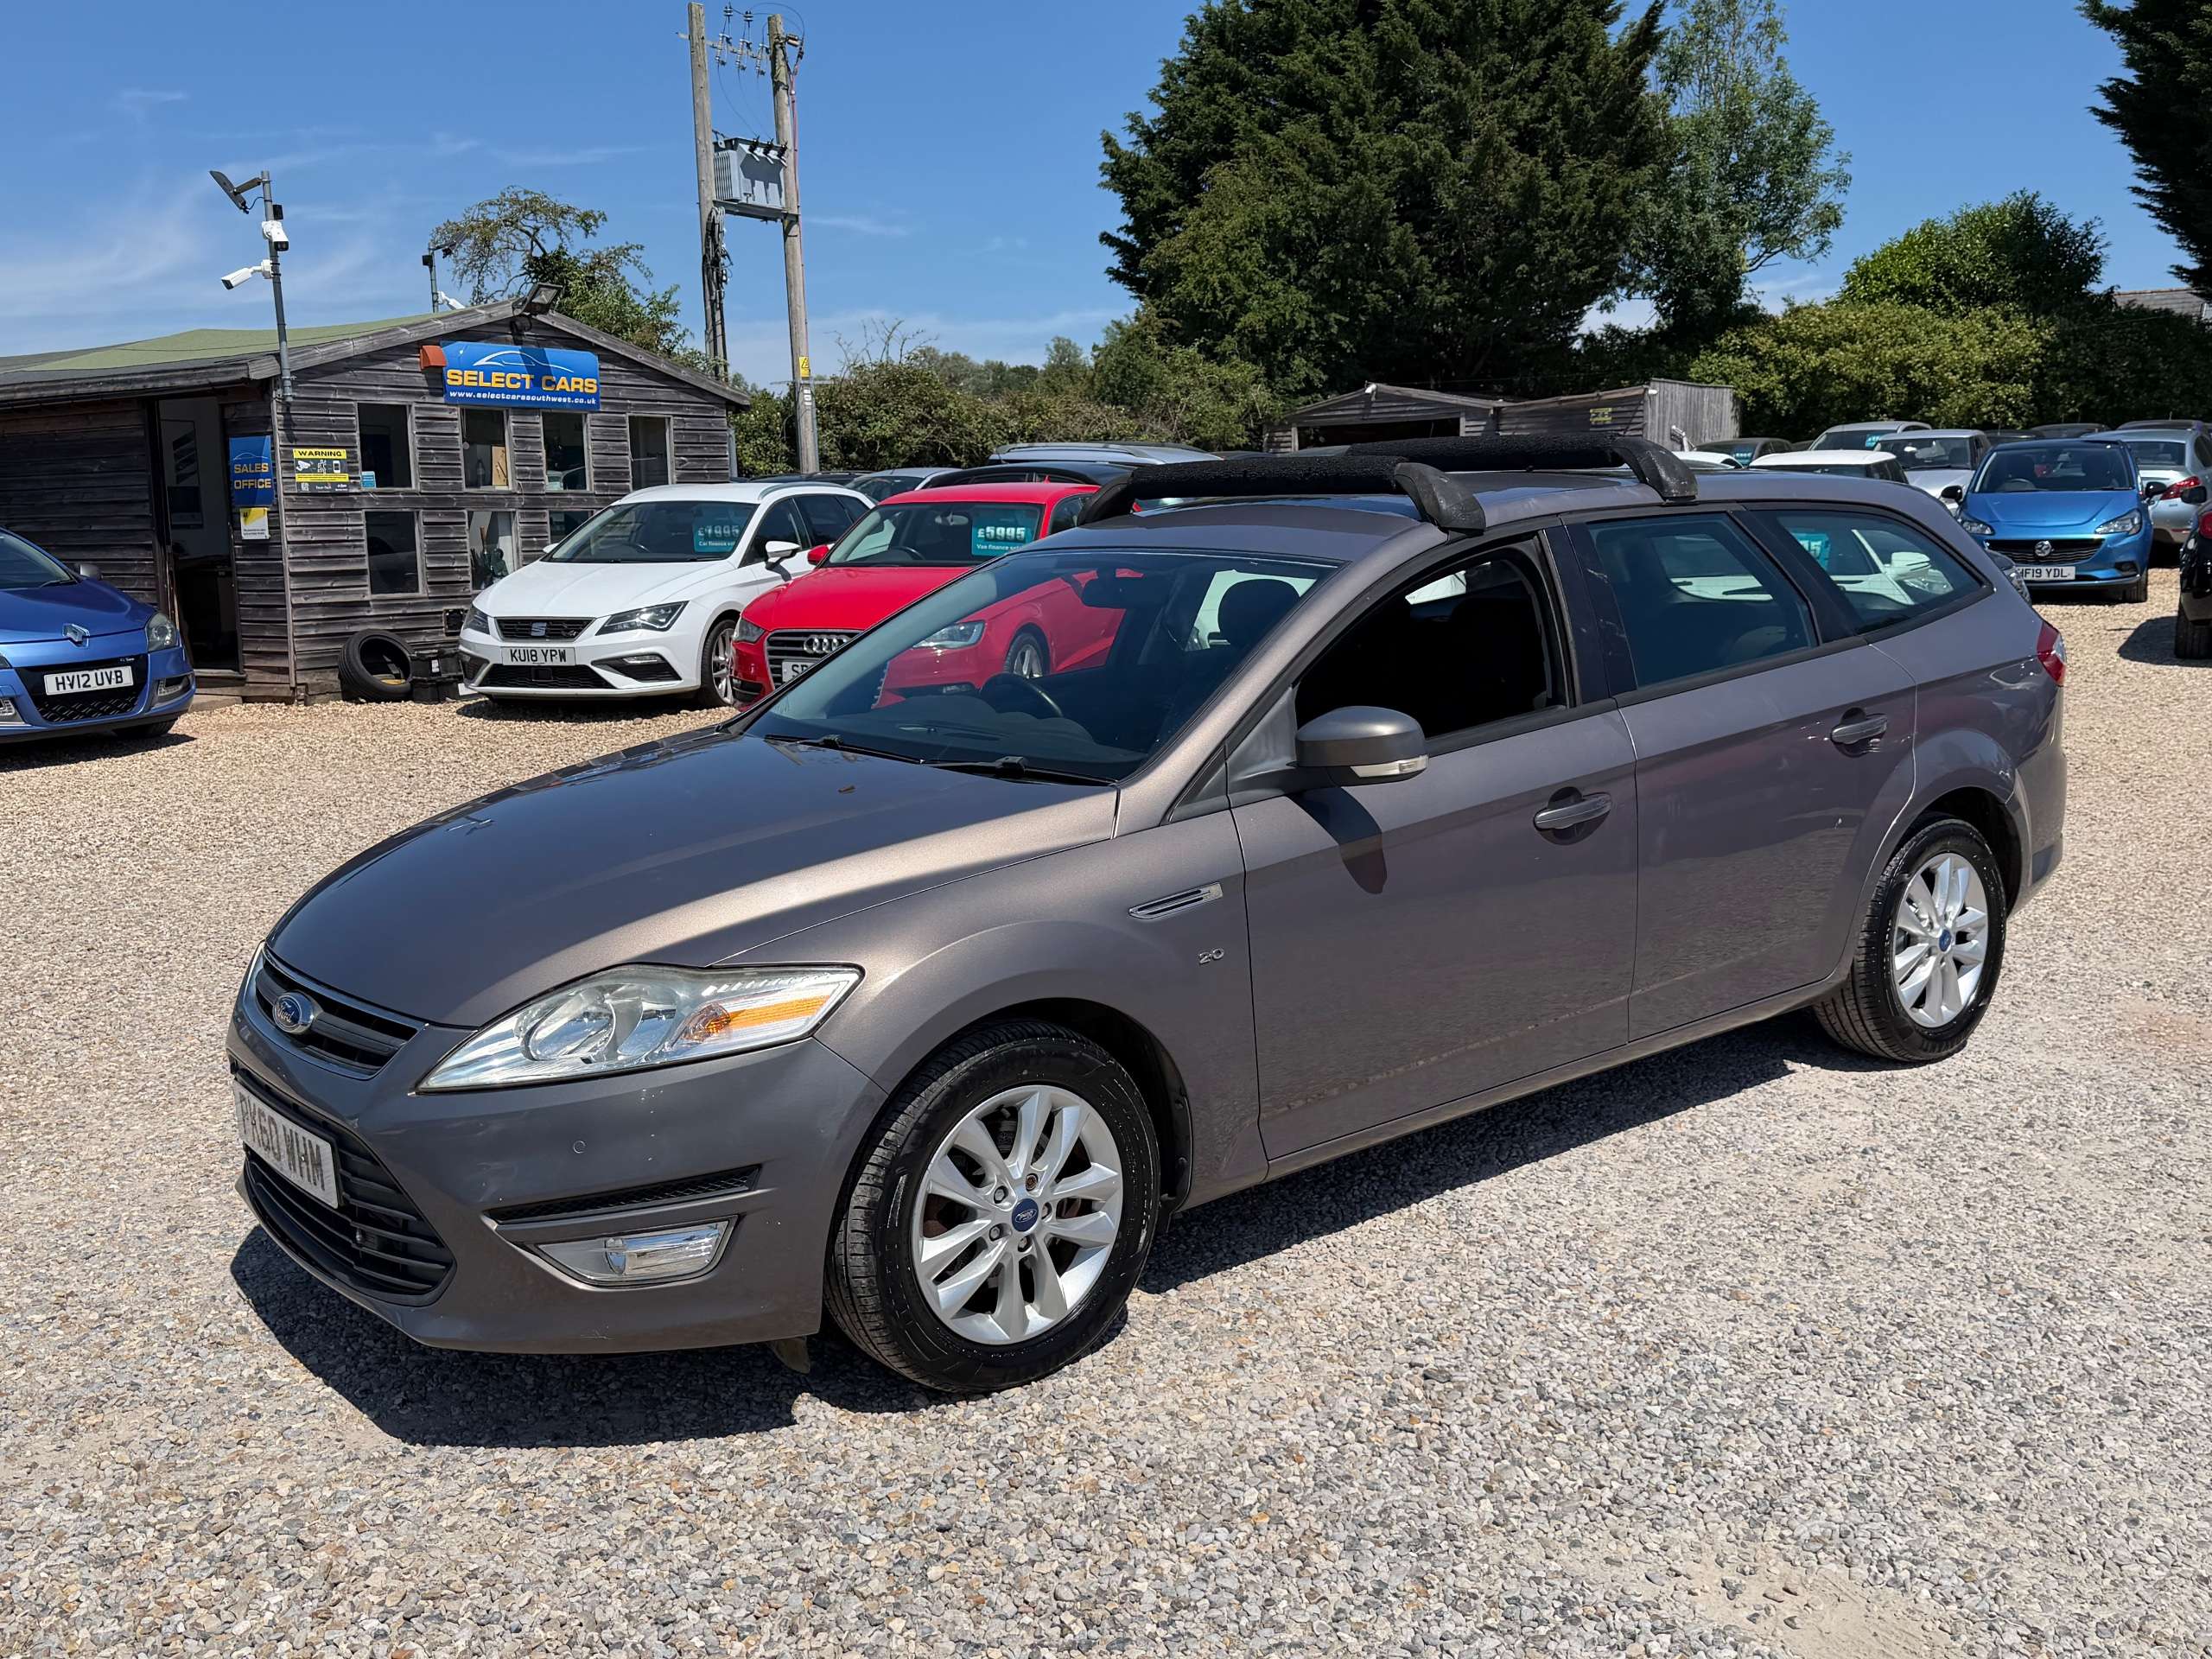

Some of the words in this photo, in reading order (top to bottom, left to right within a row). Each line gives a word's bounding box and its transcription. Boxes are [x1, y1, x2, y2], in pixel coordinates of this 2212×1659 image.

[447, 369, 534, 389] SELECT
[541, 376, 598, 394] CARS
[449, 391, 596, 405] www.selectcarssouthwest.co.uk
[234, 463, 269, 474] SALES
[234, 479, 271, 490] OFFICE
[977, 526, 1026, 541] £5995
[2045, 568, 2068, 578] YDL
[510, 649, 537, 662] KU18
[541, 649, 567, 663] YPW
[55, 673, 92, 690] HV12
[94, 670, 124, 686] UVB
[283, 1123, 326, 1192] WHM
